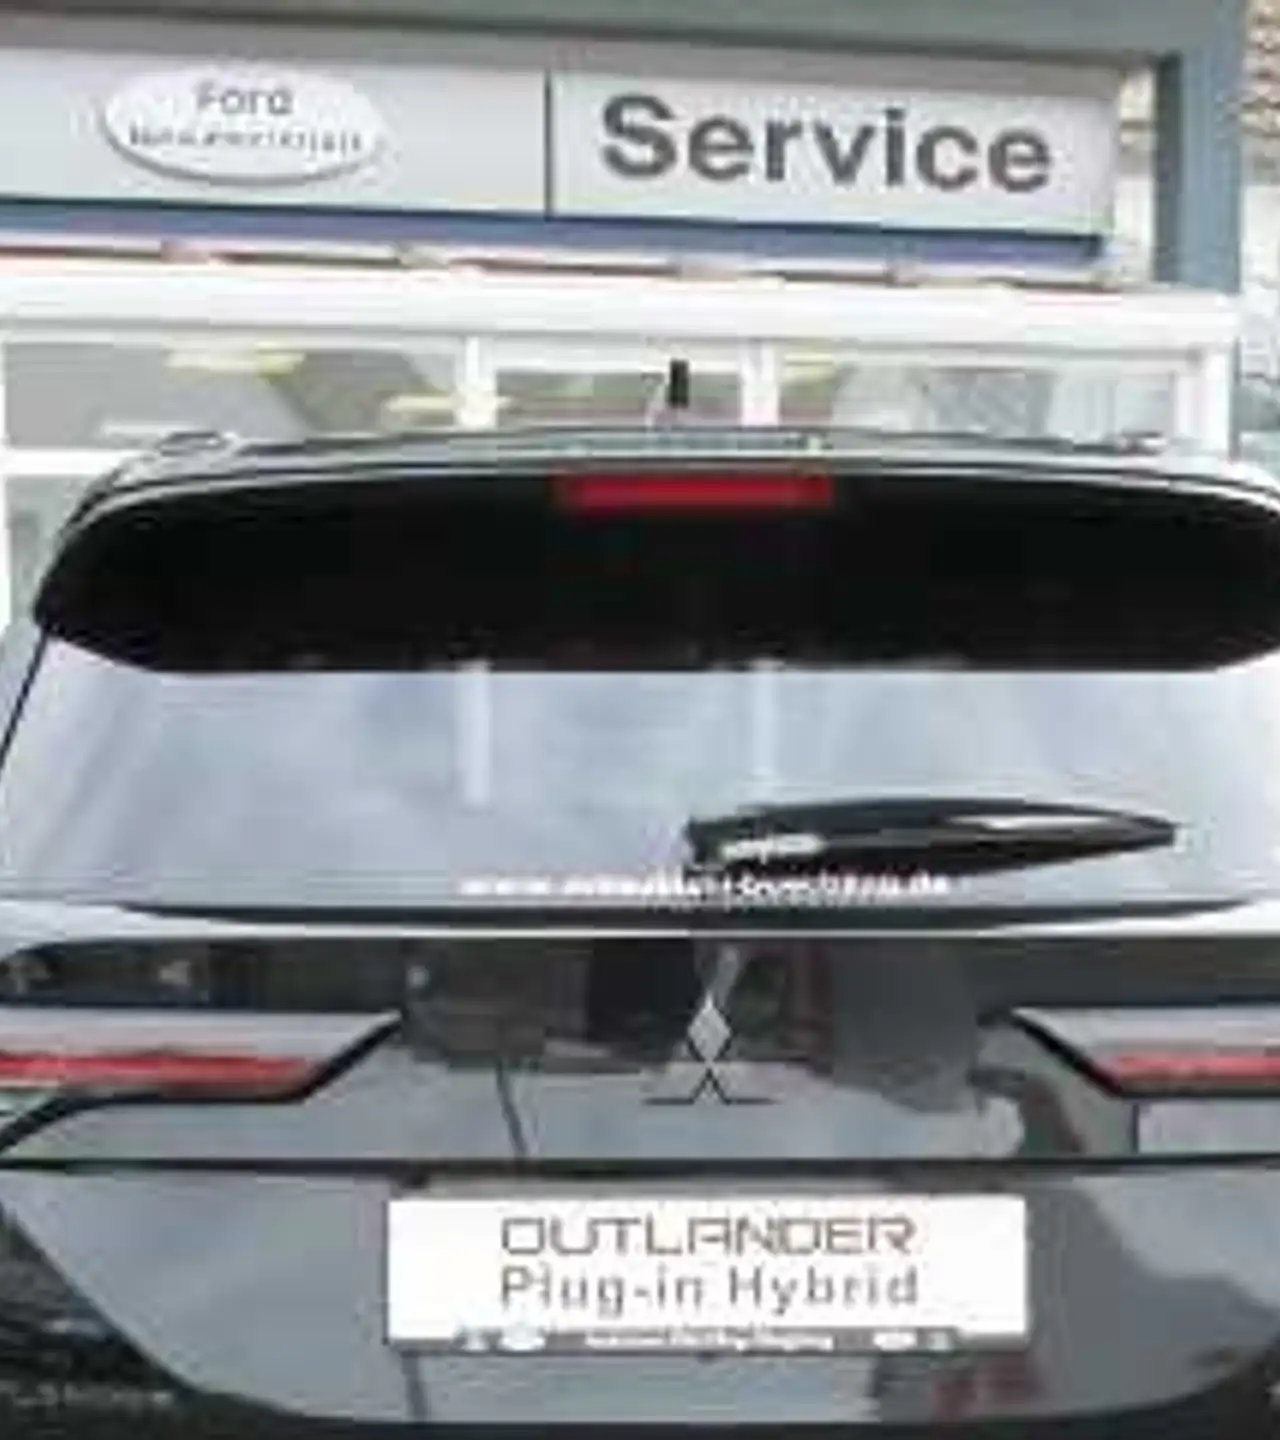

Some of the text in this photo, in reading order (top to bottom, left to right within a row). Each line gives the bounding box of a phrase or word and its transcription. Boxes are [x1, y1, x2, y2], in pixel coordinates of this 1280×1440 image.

[601, 93, 1052, 193] Service
[500, 1213, 918, 1257] OUTLANDER
[501, 1264, 920, 1318] Plug-in Hybrid
